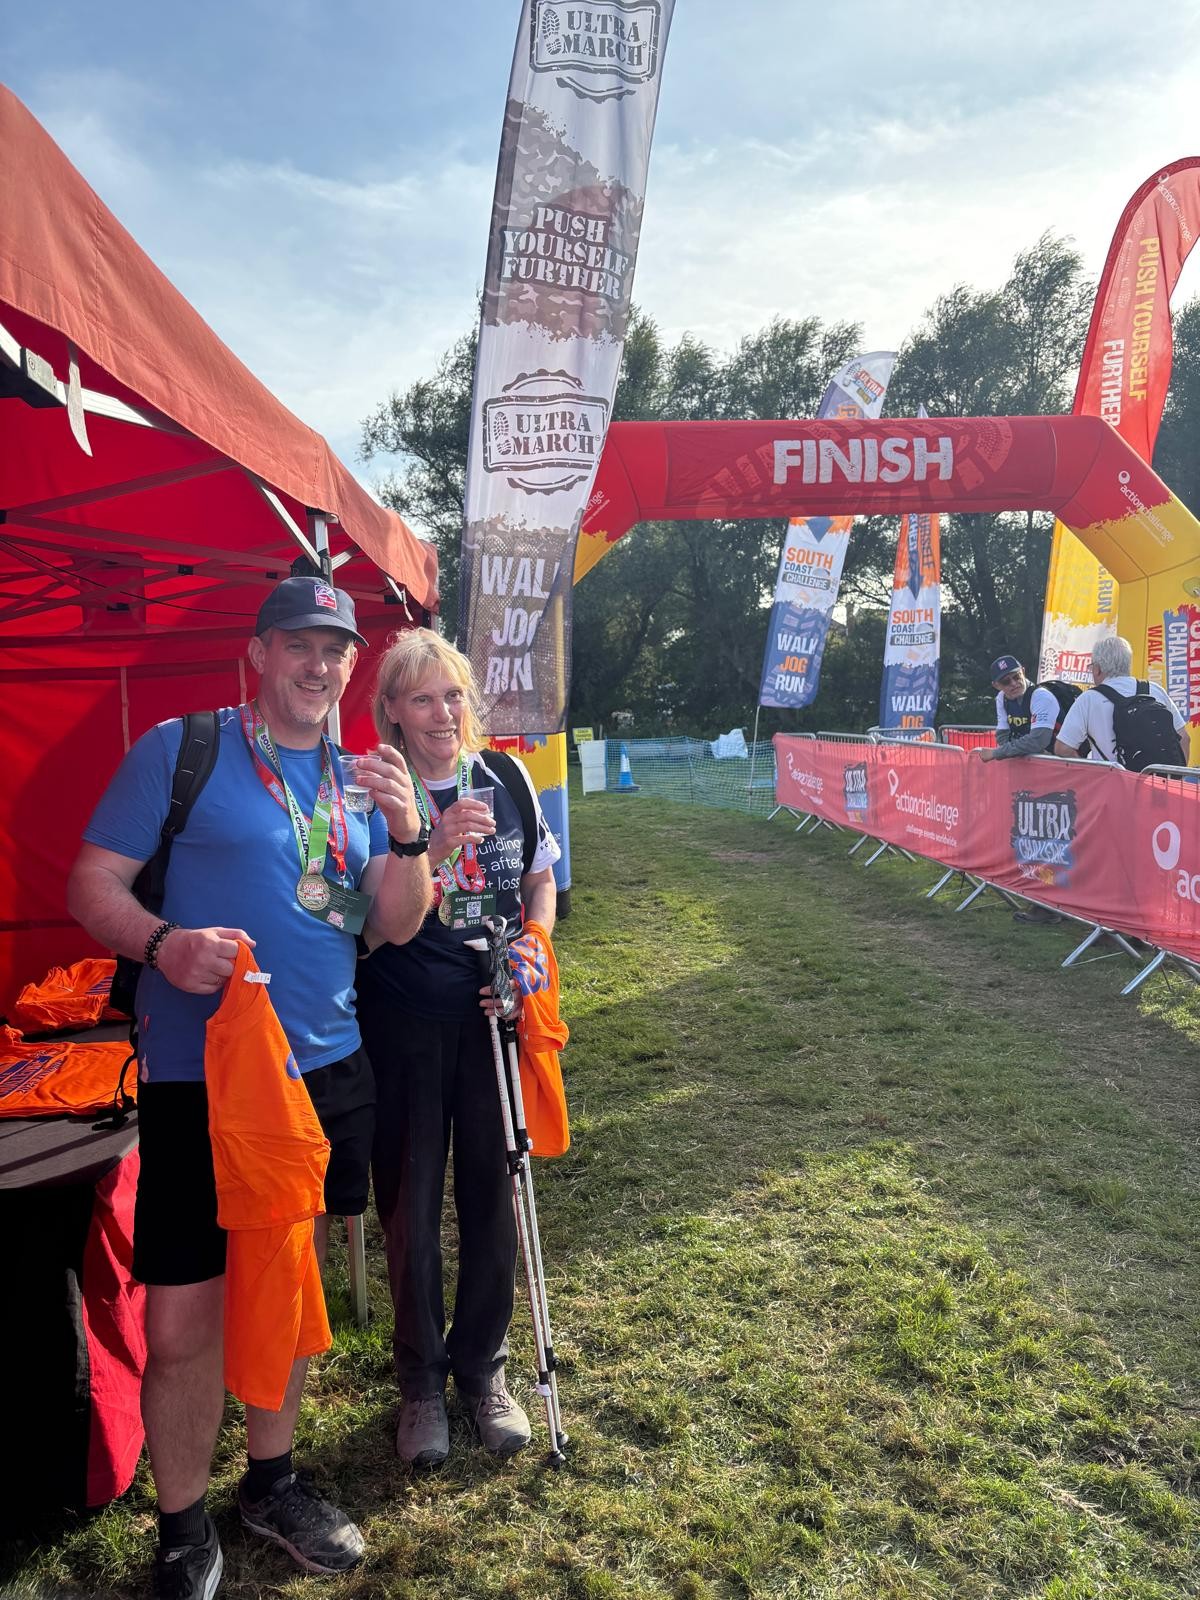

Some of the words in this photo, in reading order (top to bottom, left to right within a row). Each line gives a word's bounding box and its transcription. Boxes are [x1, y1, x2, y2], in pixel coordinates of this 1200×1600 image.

[566, 10, 641, 42] ULTRA
[562, 33, 643, 66] MARCH
[534, 206, 607, 243] PUSH
[503, 230, 629, 276] YOURSELF
[501, 256, 621, 299] FURTHER
[1135, 236, 1160, 296] PUSH
[1128, 300, 1155, 402] YOURSELF
[1100, 338, 1125, 427] FURTHER
[515, 410, 592, 433] ULTRA
[511, 433, 596, 455] MARCH
[773, 437, 954, 485] FINISH
[784, 562, 813, 575] COAST
[786, 547, 834, 570] SOUTH
[786, 573, 829, 590] CHALLENGE
[893, 608, 934, 625] SOUTH
[891, 624, 915, 633] COAST
[894, 632, 933, 645] CHALLENGE
[777, 633, 818, 654] WALK
[780, 656, 808, 673] JOG
[1061, 655, 1093, 672] ULTR
[775, 675, 805, 693] RUN
[891, 695, 932, 711] WALK
[895, 789, 959, 832] actionchallenge
[1018, 801, 1070, 840] ULTRA
[476, 837, 520, 857] uilding
